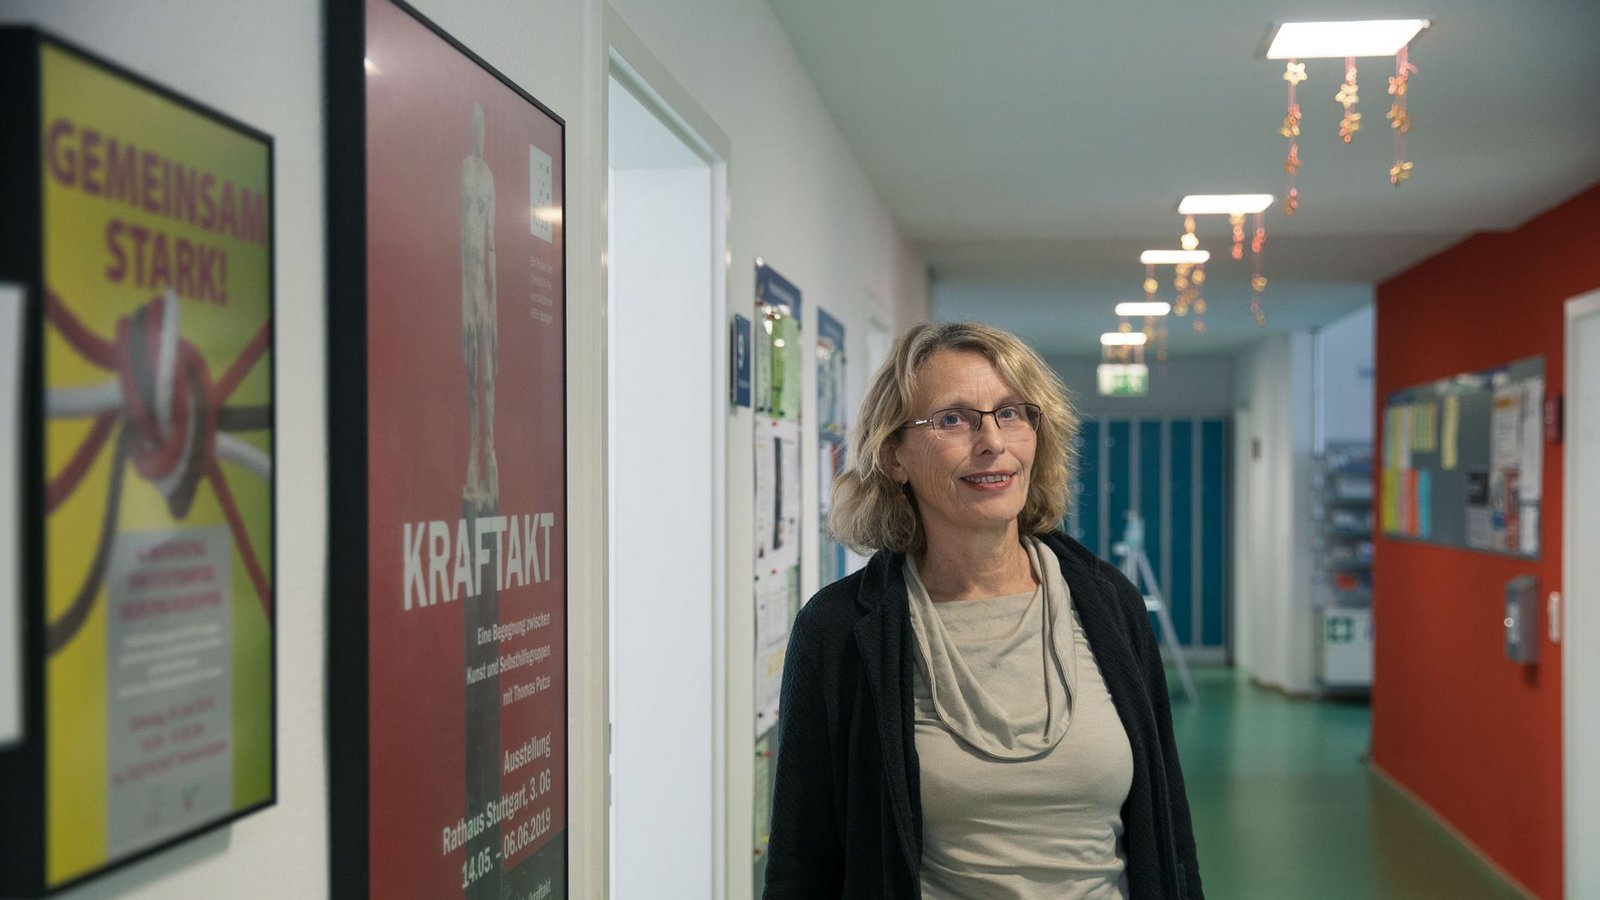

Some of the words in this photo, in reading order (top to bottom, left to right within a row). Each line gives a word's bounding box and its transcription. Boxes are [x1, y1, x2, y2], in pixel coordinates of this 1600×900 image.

[47, 118, 267, 247] GEMEINSAM
[105, 218, 228, 306] STARK!
[403, 512, 554, 611] KRAFTAKT
[467, 664, 486, 685] Kunst
[487, 658, 499, 678] und
[499, 645, 550, 673] Selbsthilfegruppen
[477, 626, 492, 645] Eine
[493, 619, 526, 642] Begegnung
[526, 612, 550, 631] zwischen
[503, 685, 513, 706] mit
[514, 681, 535, 702] Thomas
[536, 675, 550, 694] Putze
[504, 732, 551, 775] Ausstellung
[443, 811, 484, 856] Rathaus
[486, 786, 528, 829] Stuttgart,
[530, 776, 538, 803] 3.
[539, 768, 551, 796] OG
[462, 846, 493, 890] 14.05.
[503, 807, 551, 860] 06.06.2019
